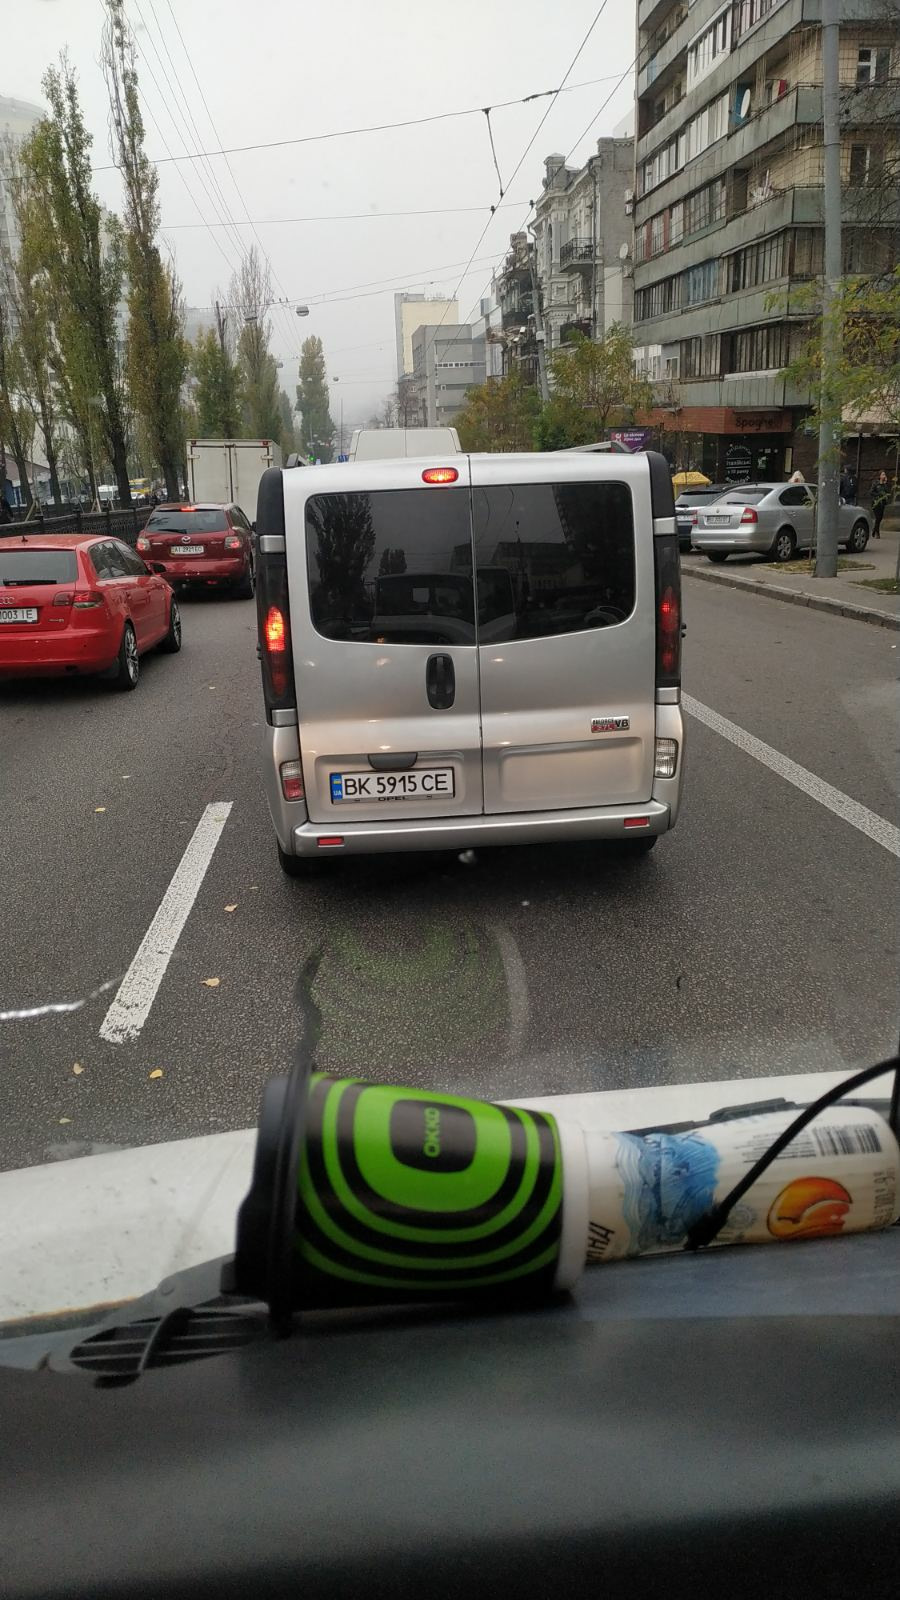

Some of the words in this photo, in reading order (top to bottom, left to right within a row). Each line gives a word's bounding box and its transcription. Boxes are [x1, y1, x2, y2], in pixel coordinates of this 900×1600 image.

[344, 777, 371, 796] BK
[376, 775, 418, 794] 5915
[421, 773, 449, 792] CE
[423, 1106, 441, 1159] OKKO
